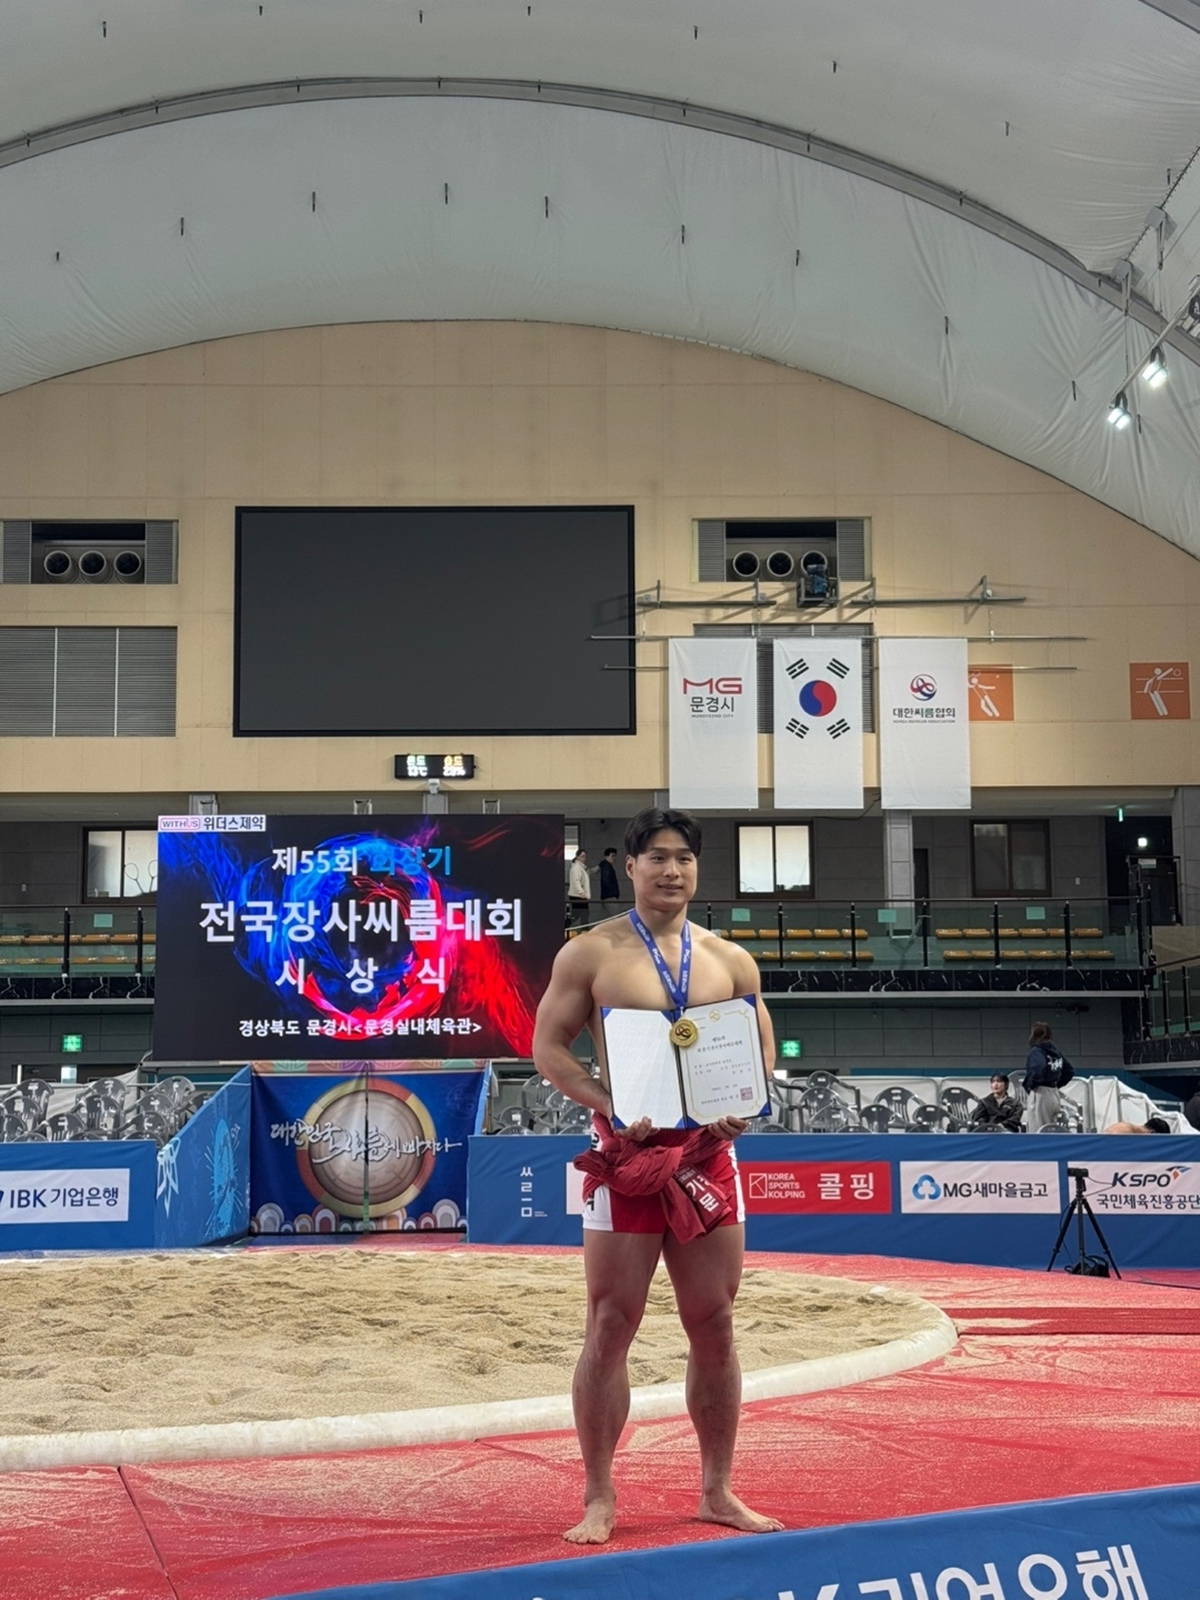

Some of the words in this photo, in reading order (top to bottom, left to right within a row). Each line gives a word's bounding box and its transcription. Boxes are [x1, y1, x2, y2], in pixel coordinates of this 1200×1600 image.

[683, 677, 742, 694] MG
[690, 696, 734, 713] 문경시
[892, 707, 956, 719] 대한씨름협회
[162, 820, 199, 829] WITHUS
[203, 816, 264, 831] 위더스제약
[272, 846, 358, 877] 제55회
[199, 898, 522, 943] 전국장사씨름대회
[239, 1019, 301, 1038] 경상북도
[767, 1173, 795, 1181] KOREA
[768, 1181, 800, 1190] SPORTS
[1111, 1172, 1171, 1188] KSPO
[768, 1190, 806, 1199] KOLPING
[817, 1172, 875, 1201] 콜핑
[1096, 1193, 1200, 1210] 국민체육진흥공단
